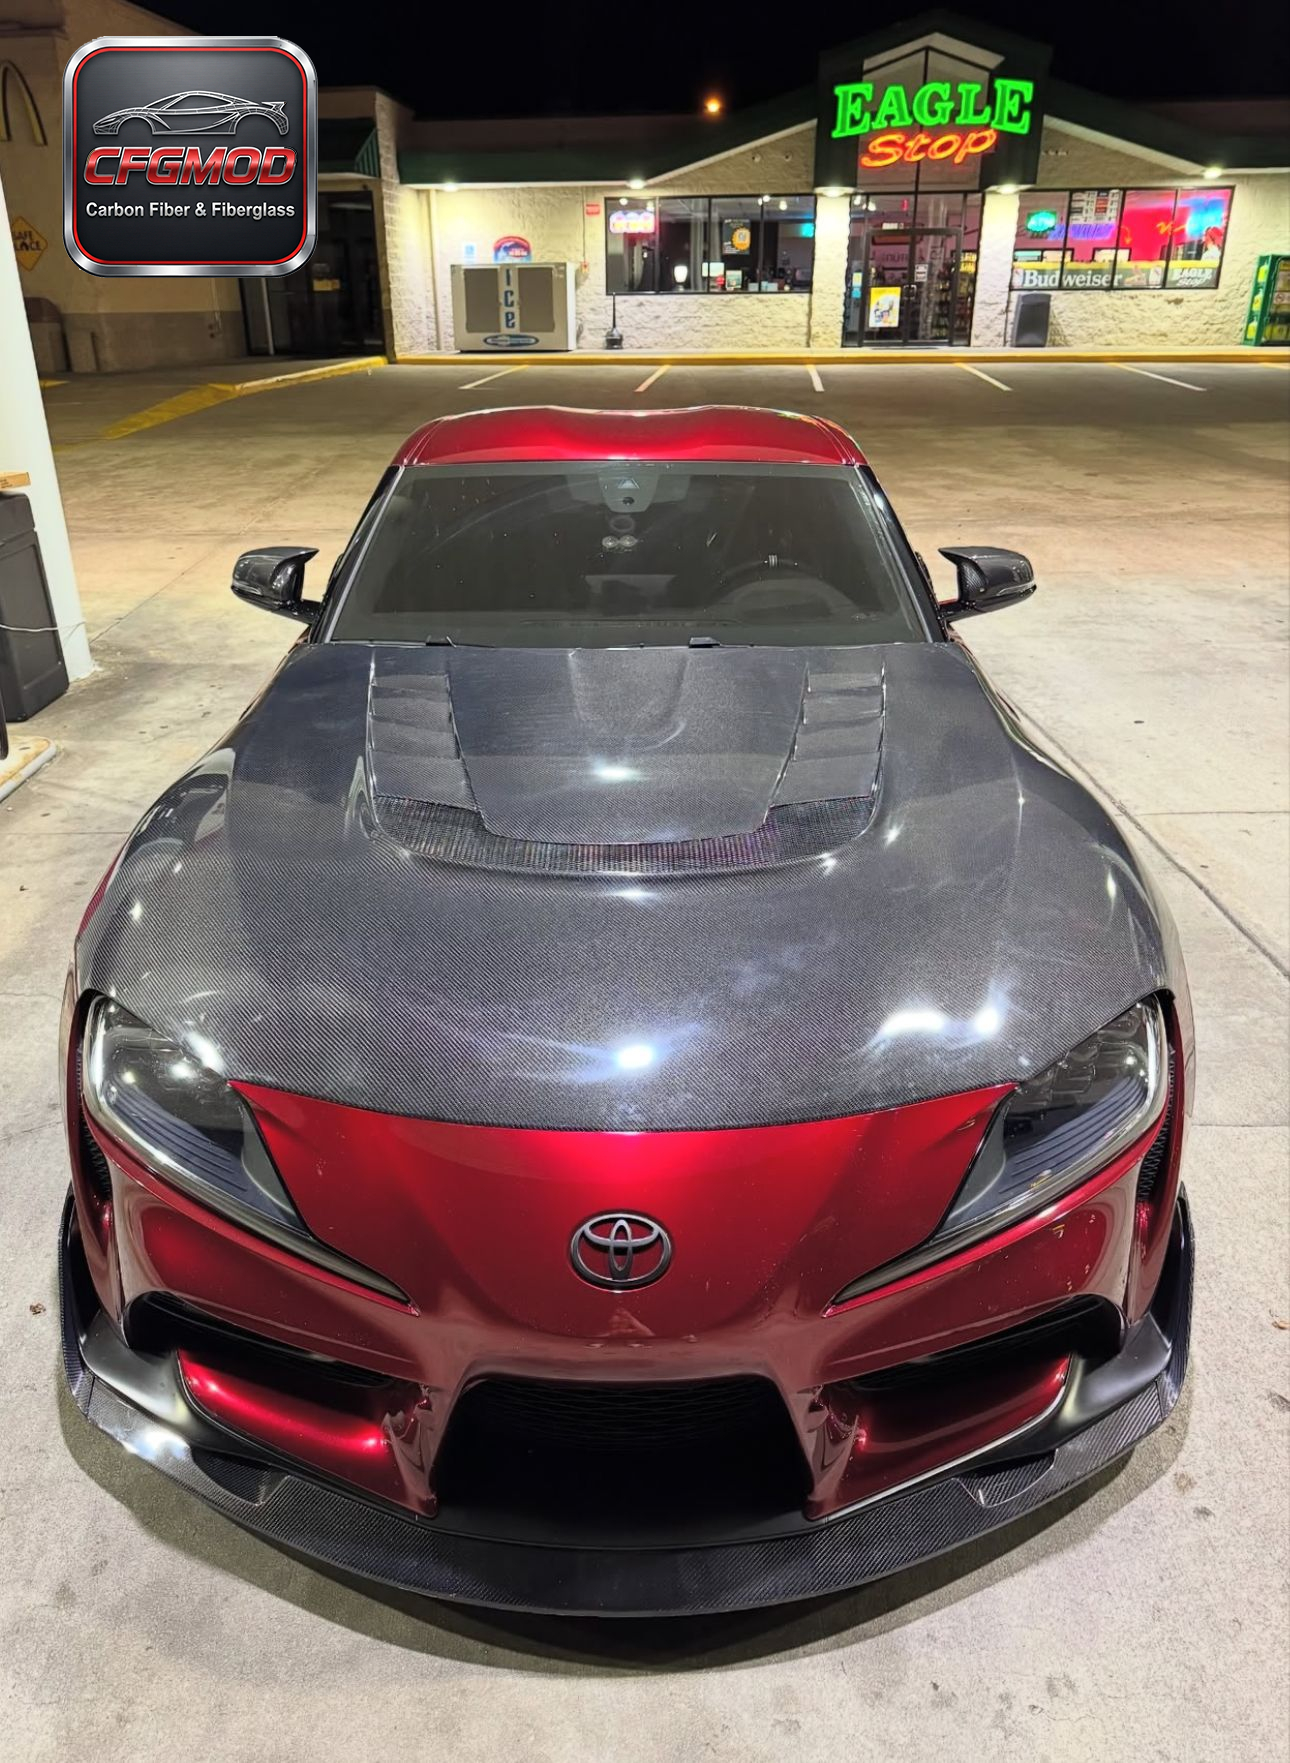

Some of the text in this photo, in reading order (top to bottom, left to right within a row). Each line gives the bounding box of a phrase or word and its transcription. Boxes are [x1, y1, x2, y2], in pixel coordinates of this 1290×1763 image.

[831, 78, 1034, 139] EAGLE
[860, 128, 998, 168] Stop
[1023, 269, 1124, 287] Budweiser
